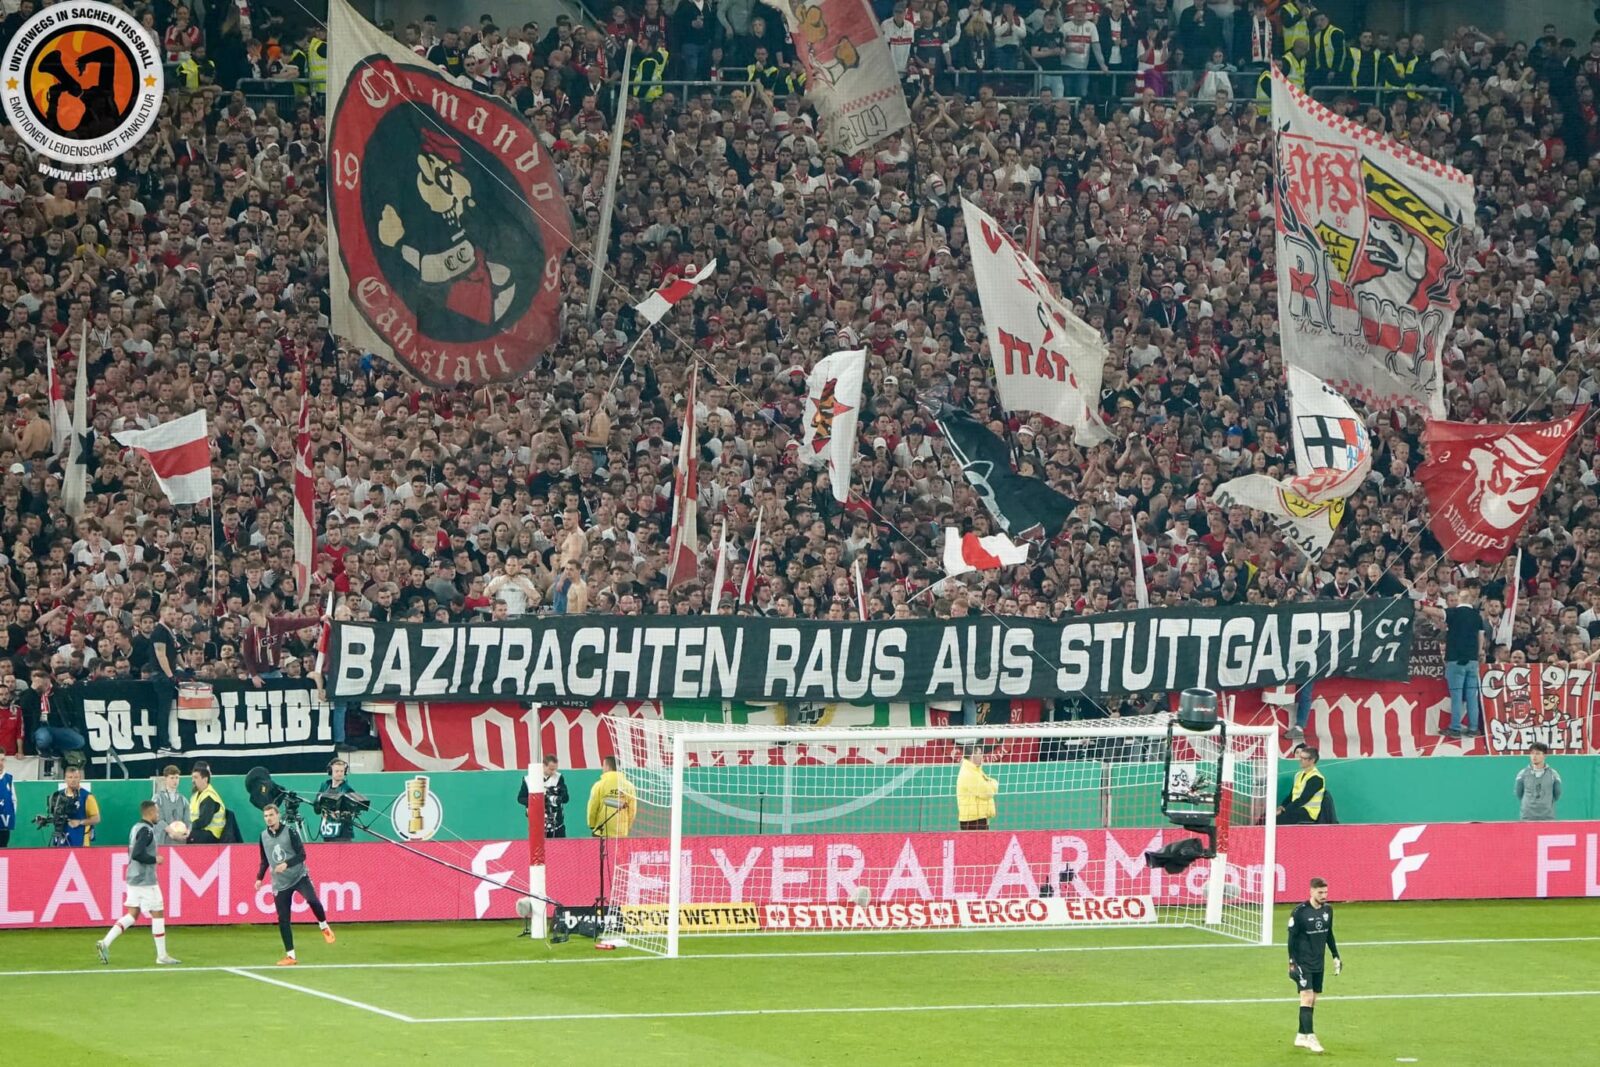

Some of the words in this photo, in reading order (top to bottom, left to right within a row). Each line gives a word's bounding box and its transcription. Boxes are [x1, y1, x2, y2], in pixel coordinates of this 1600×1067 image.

[360, 67, 553, 202] Cmando
[334, 149, 361, 191] 19
[444, 247, 473, 271] CC
[1375, 617, 1409, 638] CC
[338, 626, 743, 697] BAZITRACHTEN
[764, 627, 907, 699] RAUS
[926, 625, 1034, 697] AUS
[1059, 610, 1362, 693] STUTTGART!
[1481, 666, 1532, 699] CC
[1541, 665, 1592, 697] 97
[195, 688, 333, 746] BLEIBT
[1010, 708, 1022, 722] 97
[1490, 718, 1565, 751] SZENE
[1569, 717, 1584, 751] E
[794, 902, 926, 928] STRAUSS
[969, 899, 1048, 923] ERGO
[1067, 897, 1145, 920] ERGO
